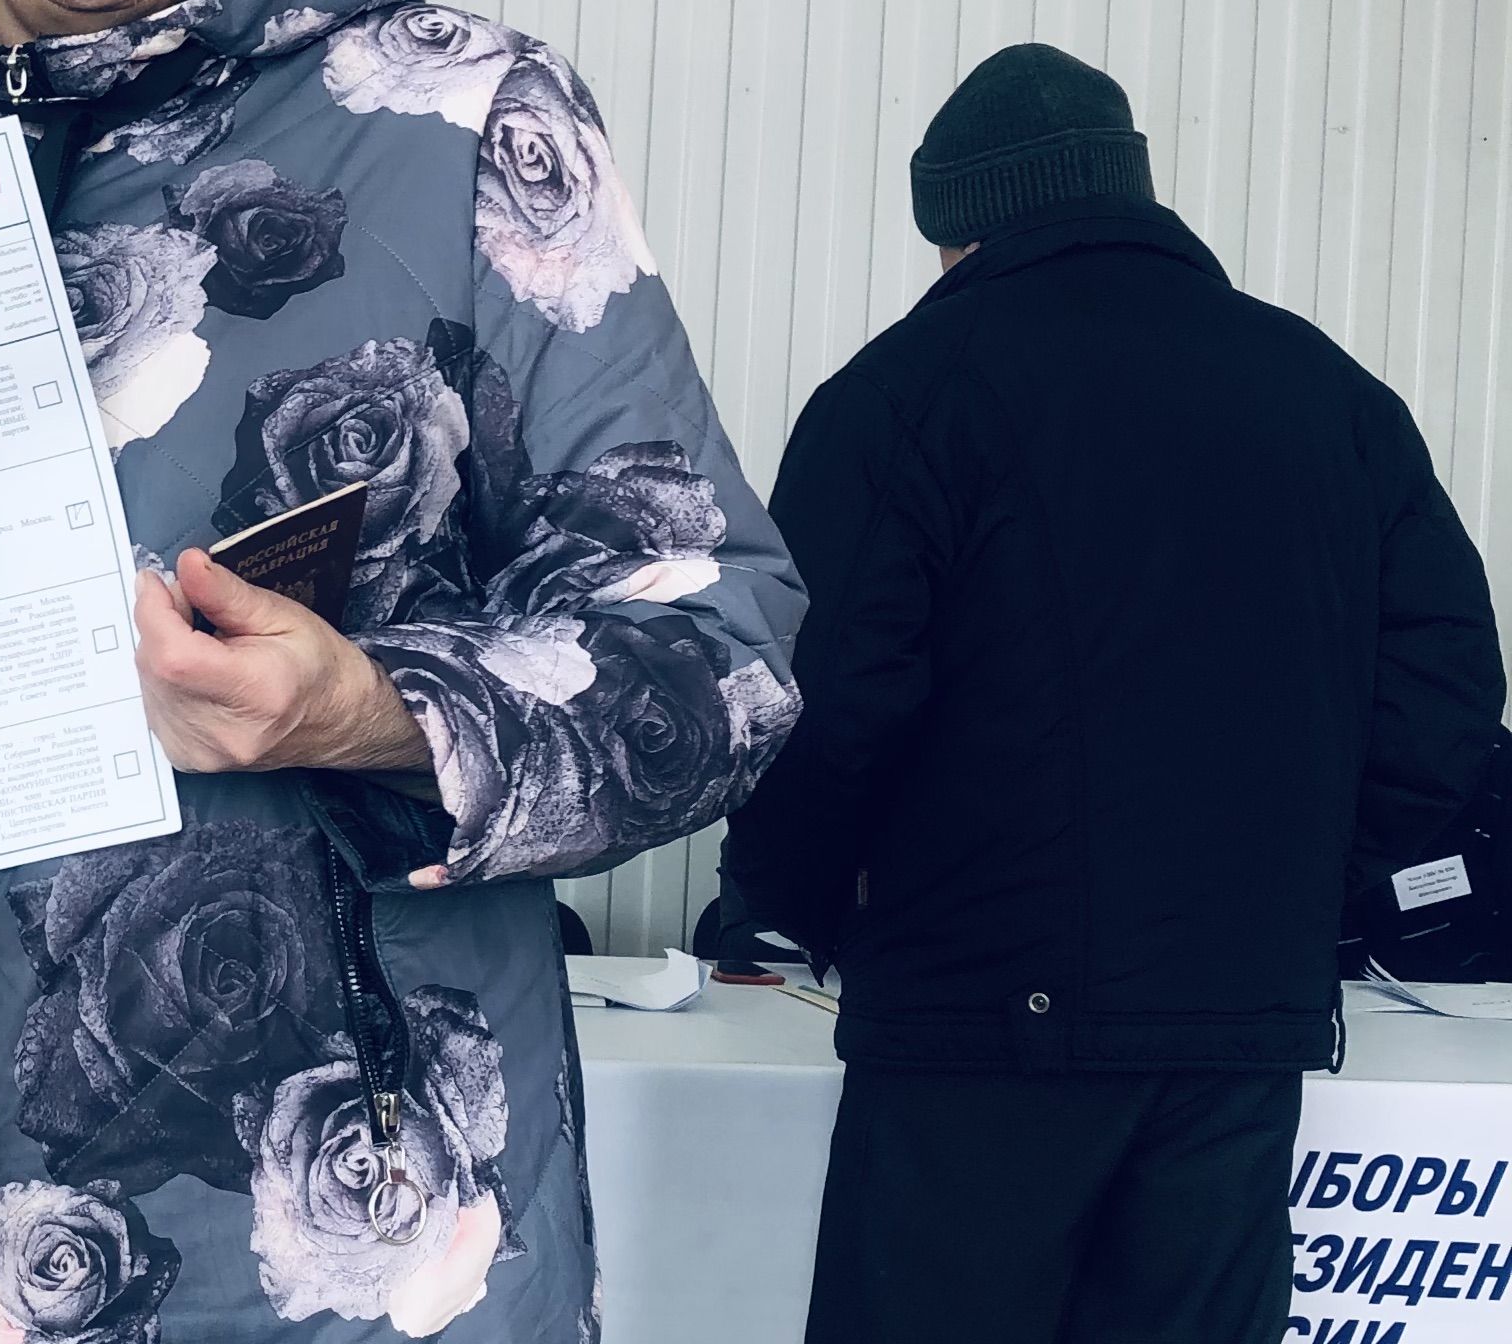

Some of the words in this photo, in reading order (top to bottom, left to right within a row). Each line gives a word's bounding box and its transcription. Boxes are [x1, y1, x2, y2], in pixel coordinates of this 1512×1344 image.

[237, 519, 339, 572] РОССИЙСКАЯ
[243, 539, 330, 580] ФЕДЕРАЦИЯ
[1289, 1151, 1510, 1218] БОРЫ
[1291, 1233, 1512, 1306] ЗИДЕН
